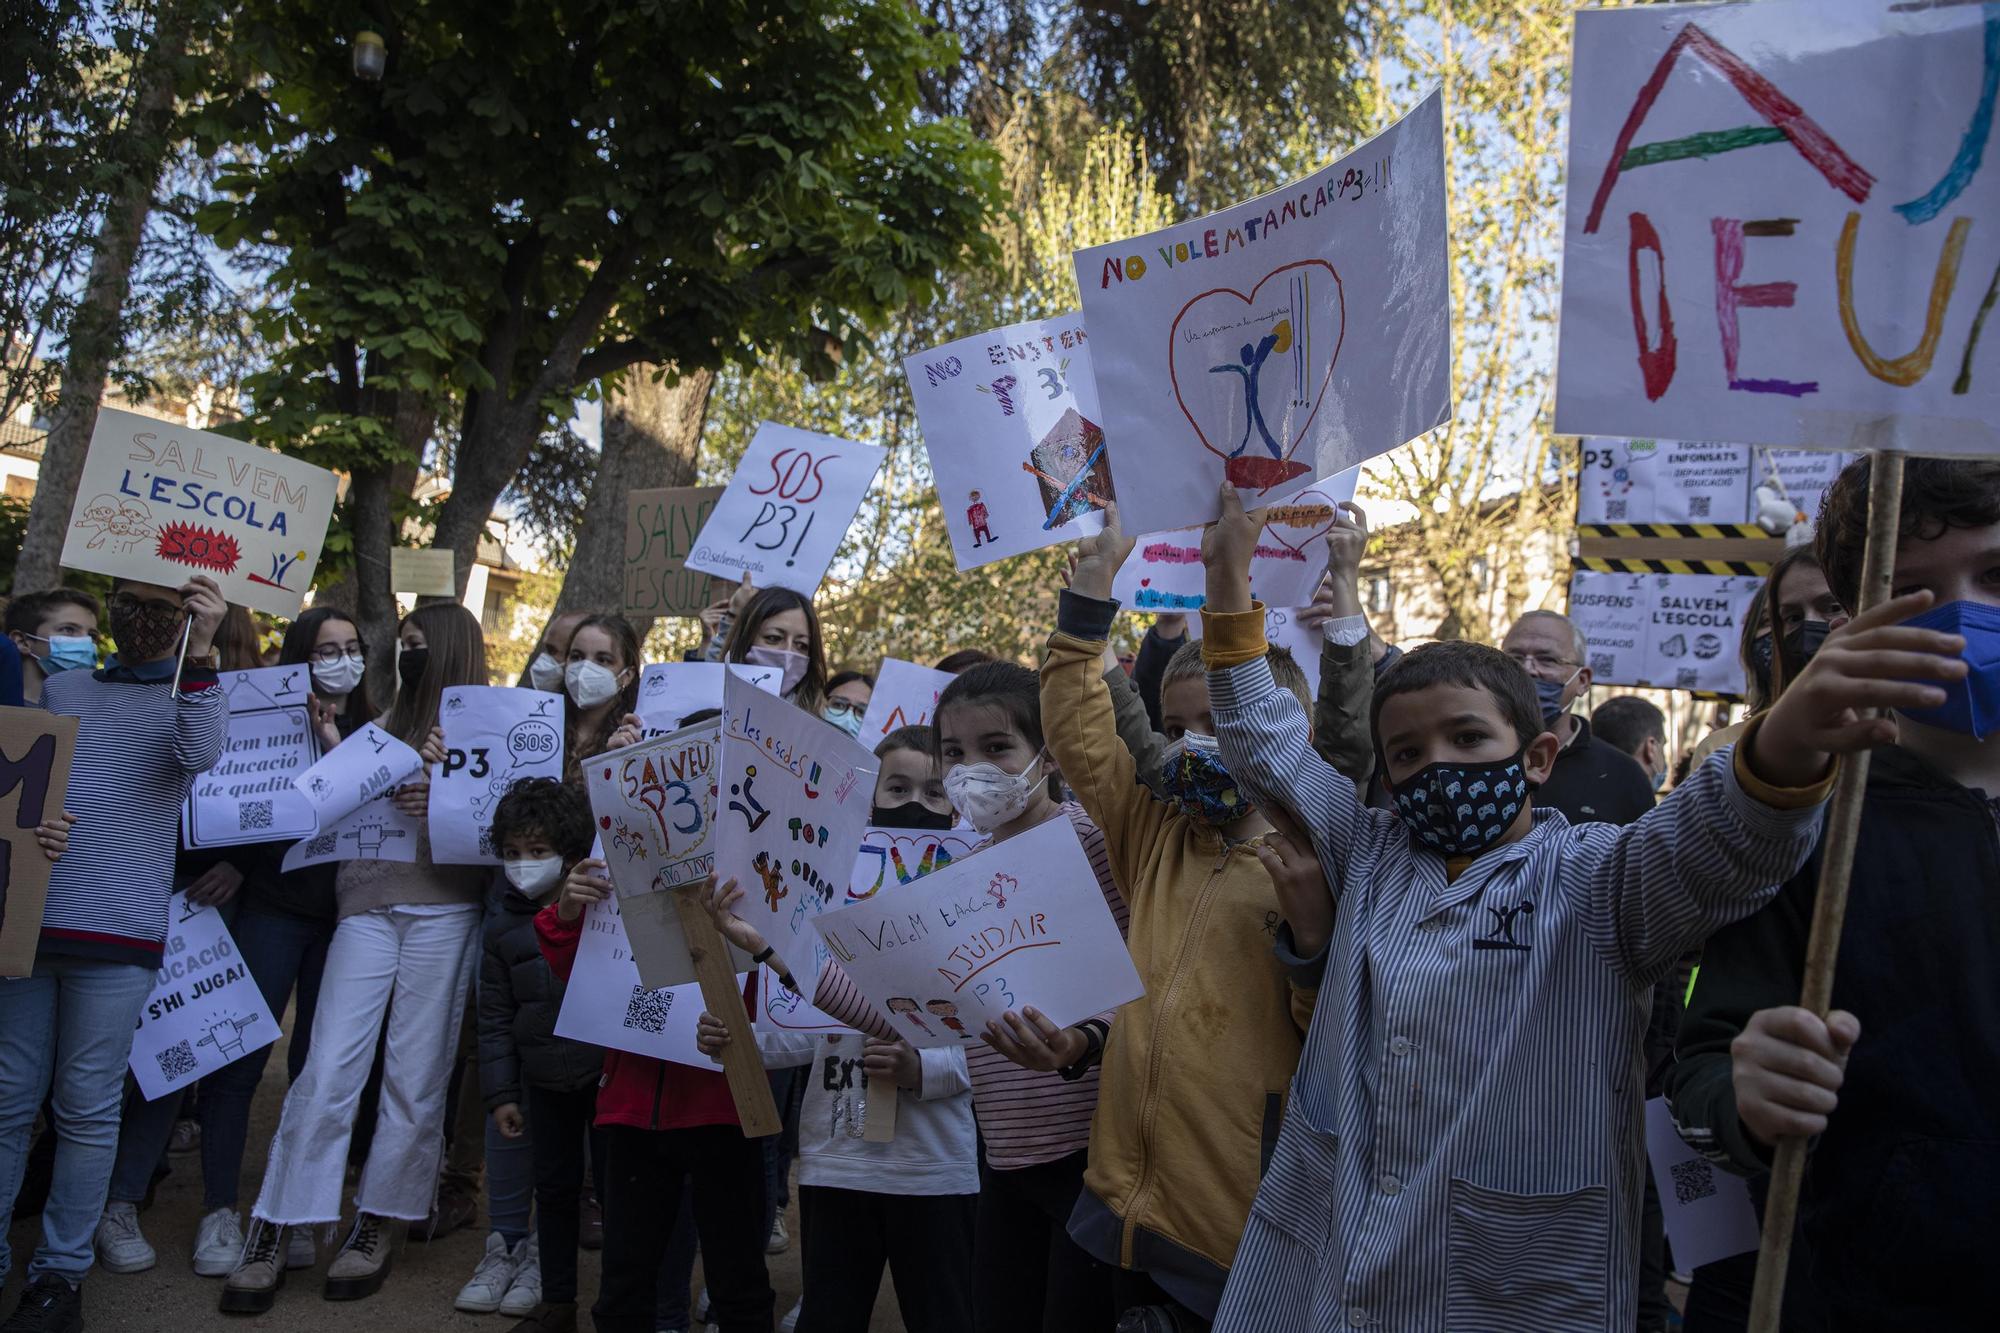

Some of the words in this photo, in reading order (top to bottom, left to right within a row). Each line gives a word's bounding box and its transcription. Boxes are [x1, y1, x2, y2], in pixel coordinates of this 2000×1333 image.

[1101, 254, 1147, 289] NO
[924, 355, 963, 388] NO
[128, 432, 309, 514] SALVEM
[749, 447, 842, 504] SOS
[1583, 450, 1614, 470] P3
[119, 468, 287, 537] L'ESCOLA
[739, 501, 815, 568] P3!
[1571, 593, 1634, 609] SUSPENS
[1660, 596, 1730, 612] SALVEM
[1652, 611, 1735, 628] L'ESCOLA
[267, 732, 304, 748] una
[513, 733, 554, 752] SOS
[442, 748, 490, 778] P3
[623, 743, 710, 798] SALVEU
[199, 783, 225, 798] de
[360, 765, 392, 800] AMB
[640, 781, 703, 855] P3
[148, 991, 185, 1020] S'HI
